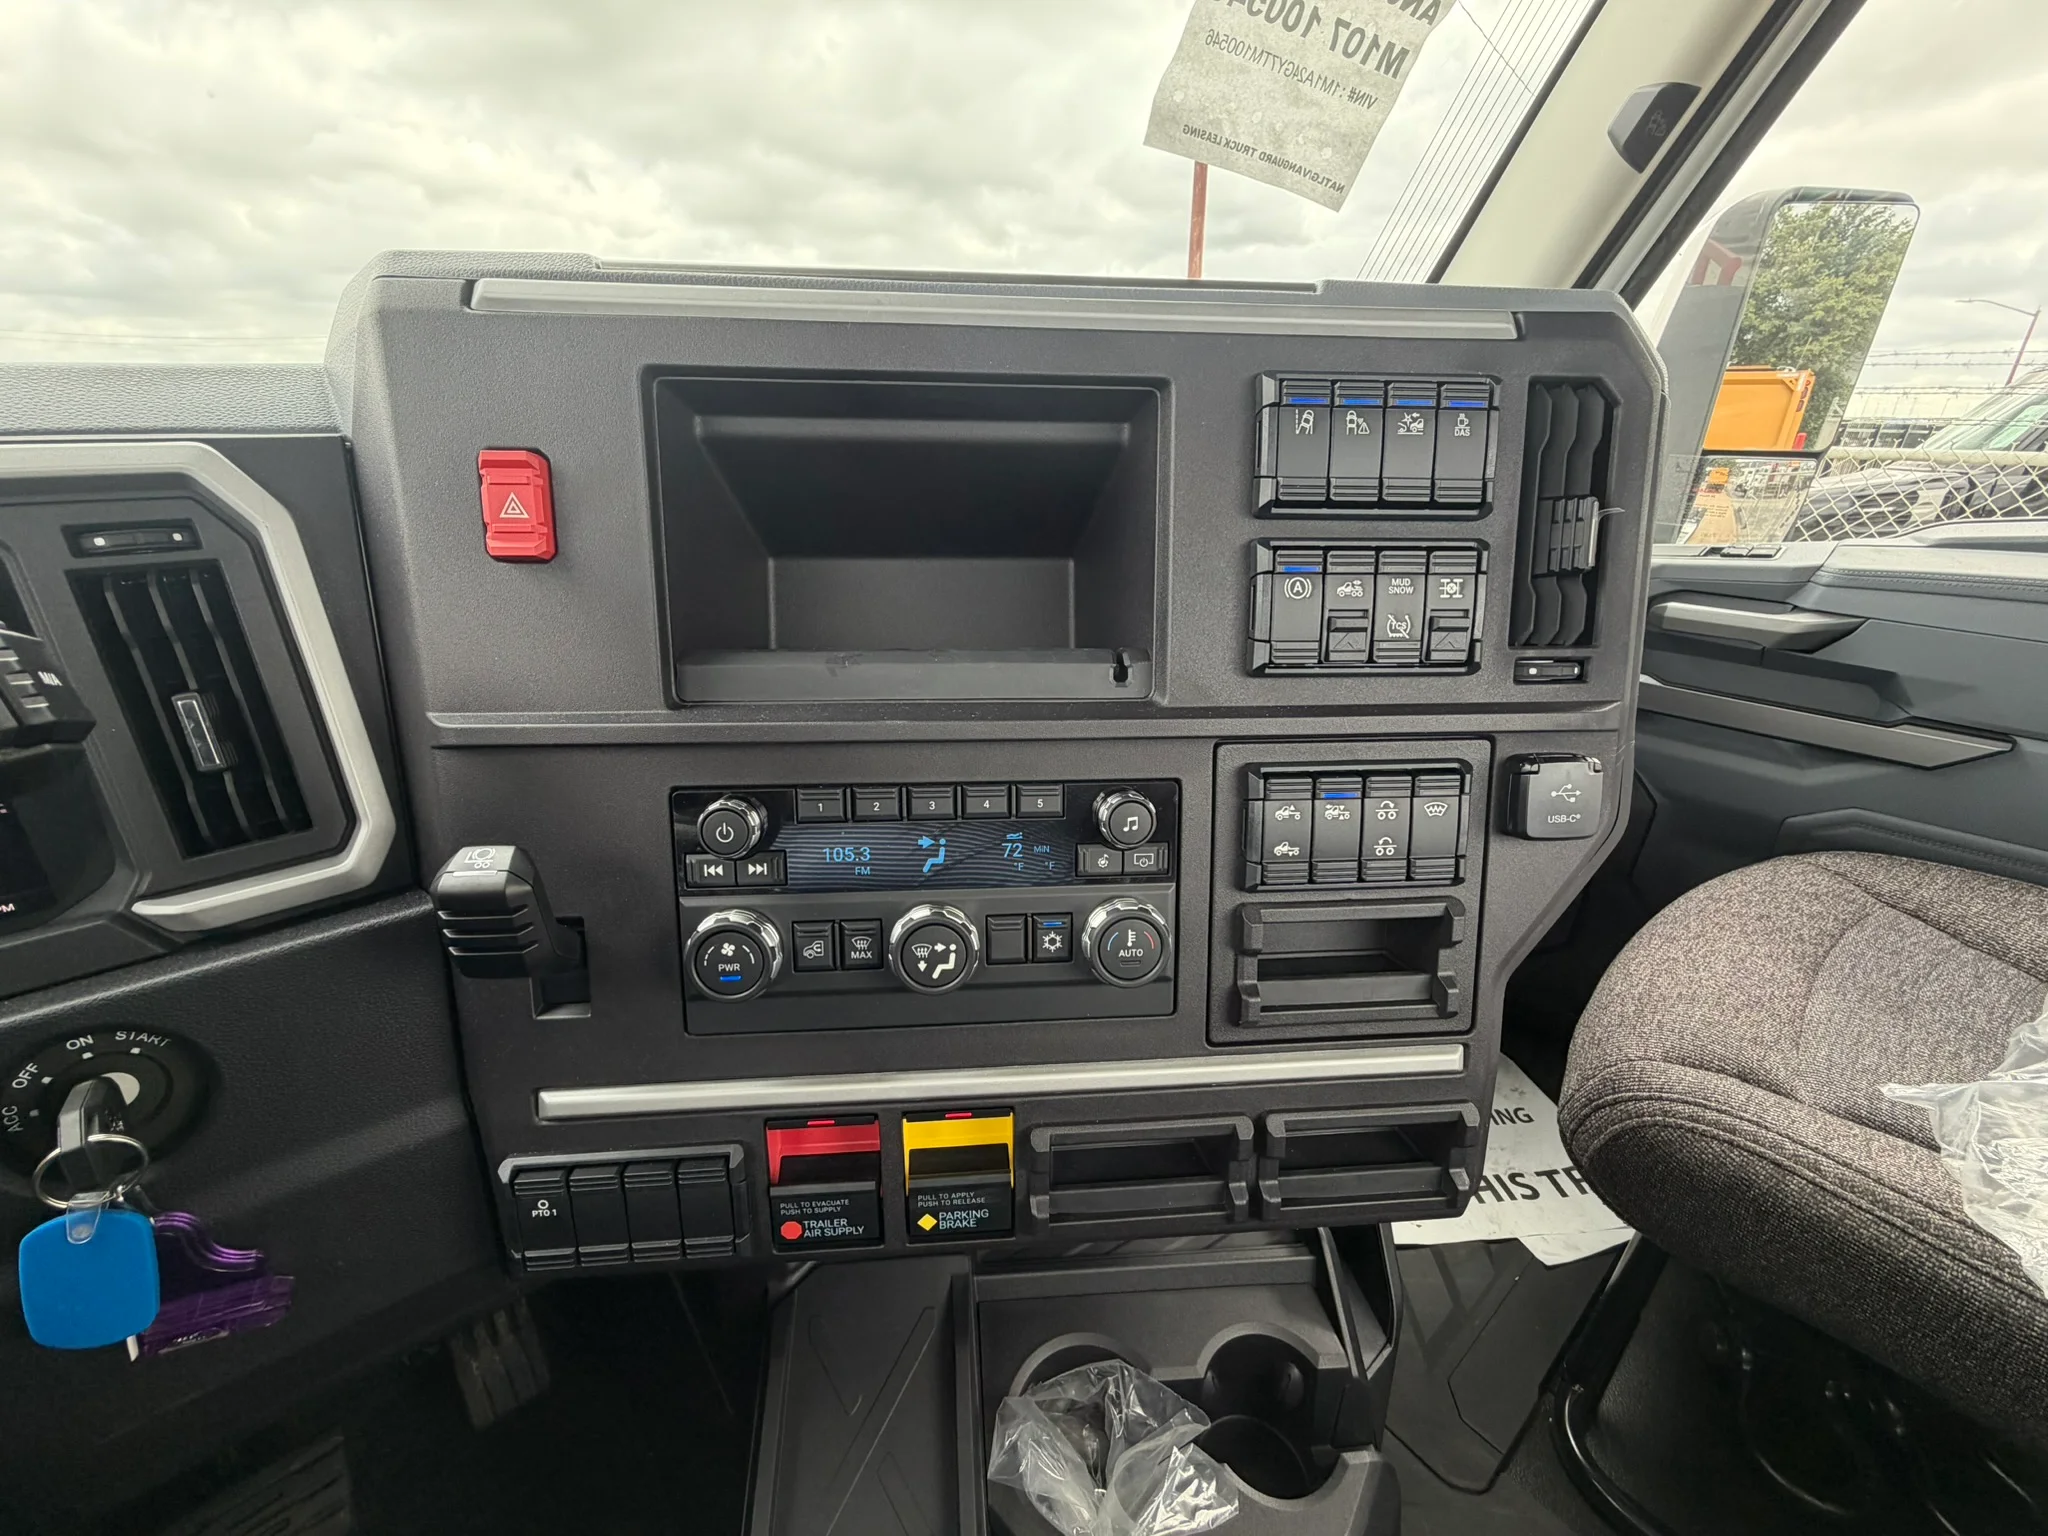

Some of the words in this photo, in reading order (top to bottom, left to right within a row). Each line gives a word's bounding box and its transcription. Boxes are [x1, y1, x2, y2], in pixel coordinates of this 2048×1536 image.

[1455, 428, 1471, 437] DAS
[1391, 578, 1411, 586] MUD
[1388, 586, 1414, 594] SNOW
[1390, 621, 1407, 630] TCS
[817, 803, 824, 812] 1
[873, 802, 880, 811] 2
[928, 801, 936, 810] 3
[983, 800, 990, 809] 4
[1037, 799, 1044, 808] 5
[1002, 843, 1024, 858] 72
[1033, 845, 1050, 853] MIN
[822, 846, 871, 863] 105.3
[855, 867, 871, 876] FM
[851, 951, 873, 959] MAX
[1118, 949, 1144, 957] AUTO
[718, 963, 741, 972] PWR
[66, 1034, 94, 1050] ON
[12, 1062, 39, 1089] OFF
[1, 1105, 24, 1133] ACC
[812, 1199, 850, 1207] EVACUATE
[952, 1197, 986, 1205] RELEASE
[532, 1209, 550, 1217] PTO
[938, 1208, 989, 1220] PARKING
[803, 1218, 848, 1229] TRAILER
[939, 1218, 977, 1230] BRAKE
[803, 1228, 822, 1238] AIR
[823, 1225, 865, 1237] SUPPLY
